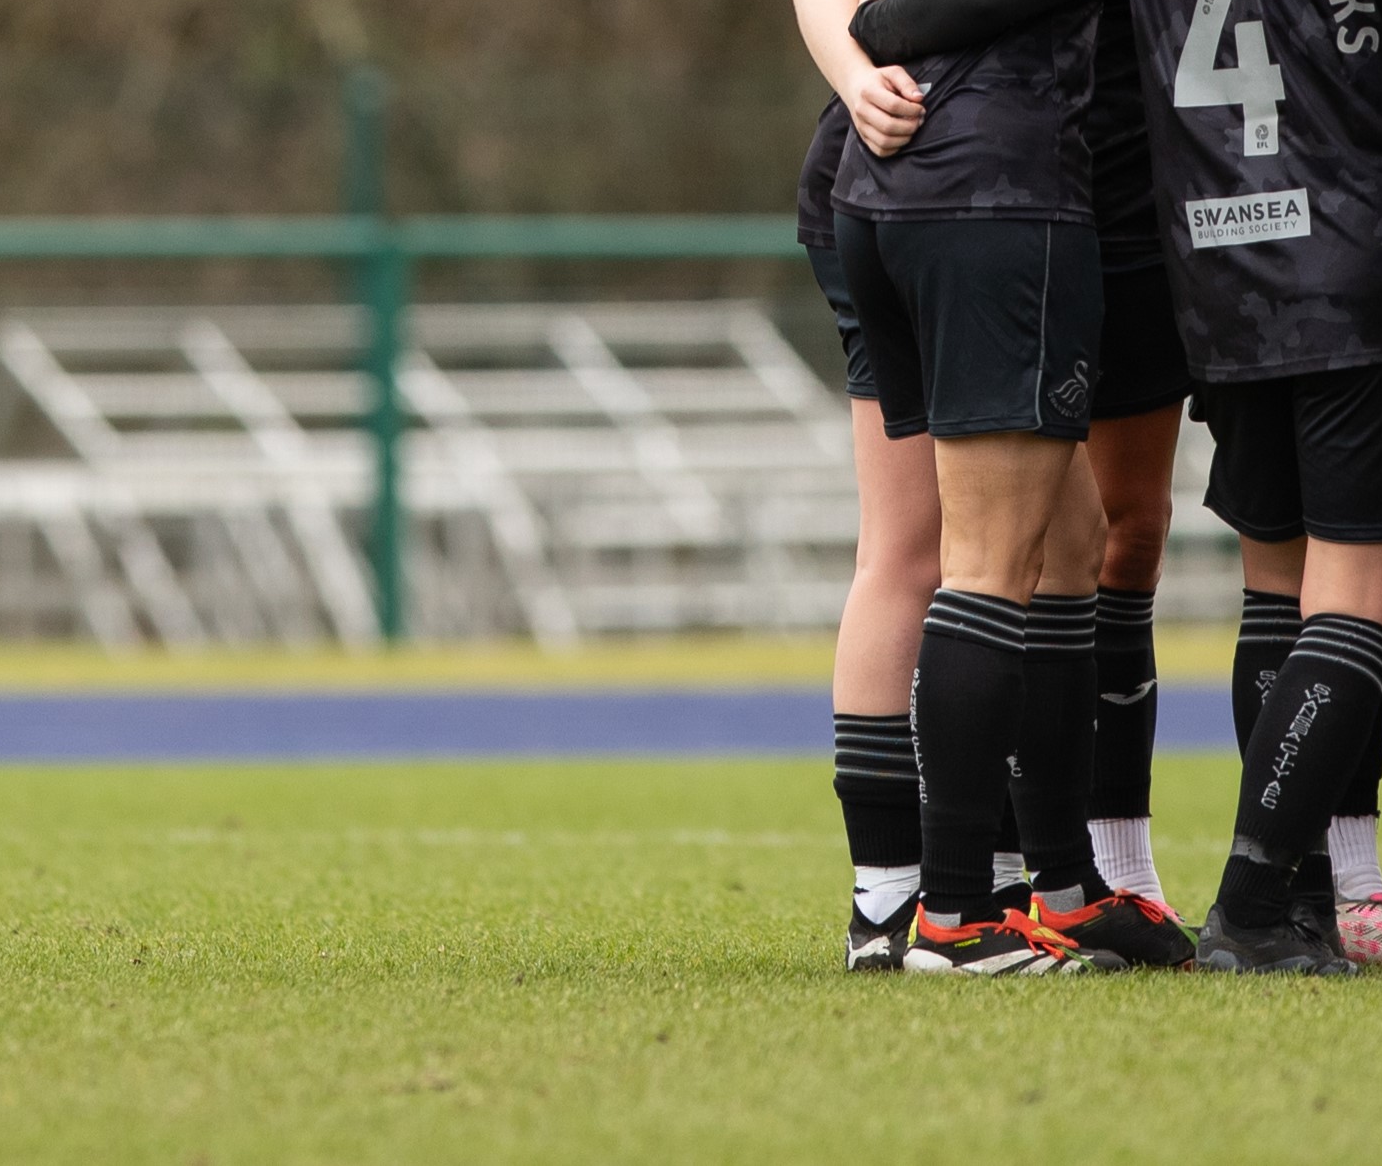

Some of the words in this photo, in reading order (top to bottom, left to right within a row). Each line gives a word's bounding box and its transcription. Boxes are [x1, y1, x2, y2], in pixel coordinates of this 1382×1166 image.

[1256, 141, 1268, 149] EFL
[1193, 199, 1301, 228] SWANSEA
[1249, 220, 1298, 235] SOCIETY
